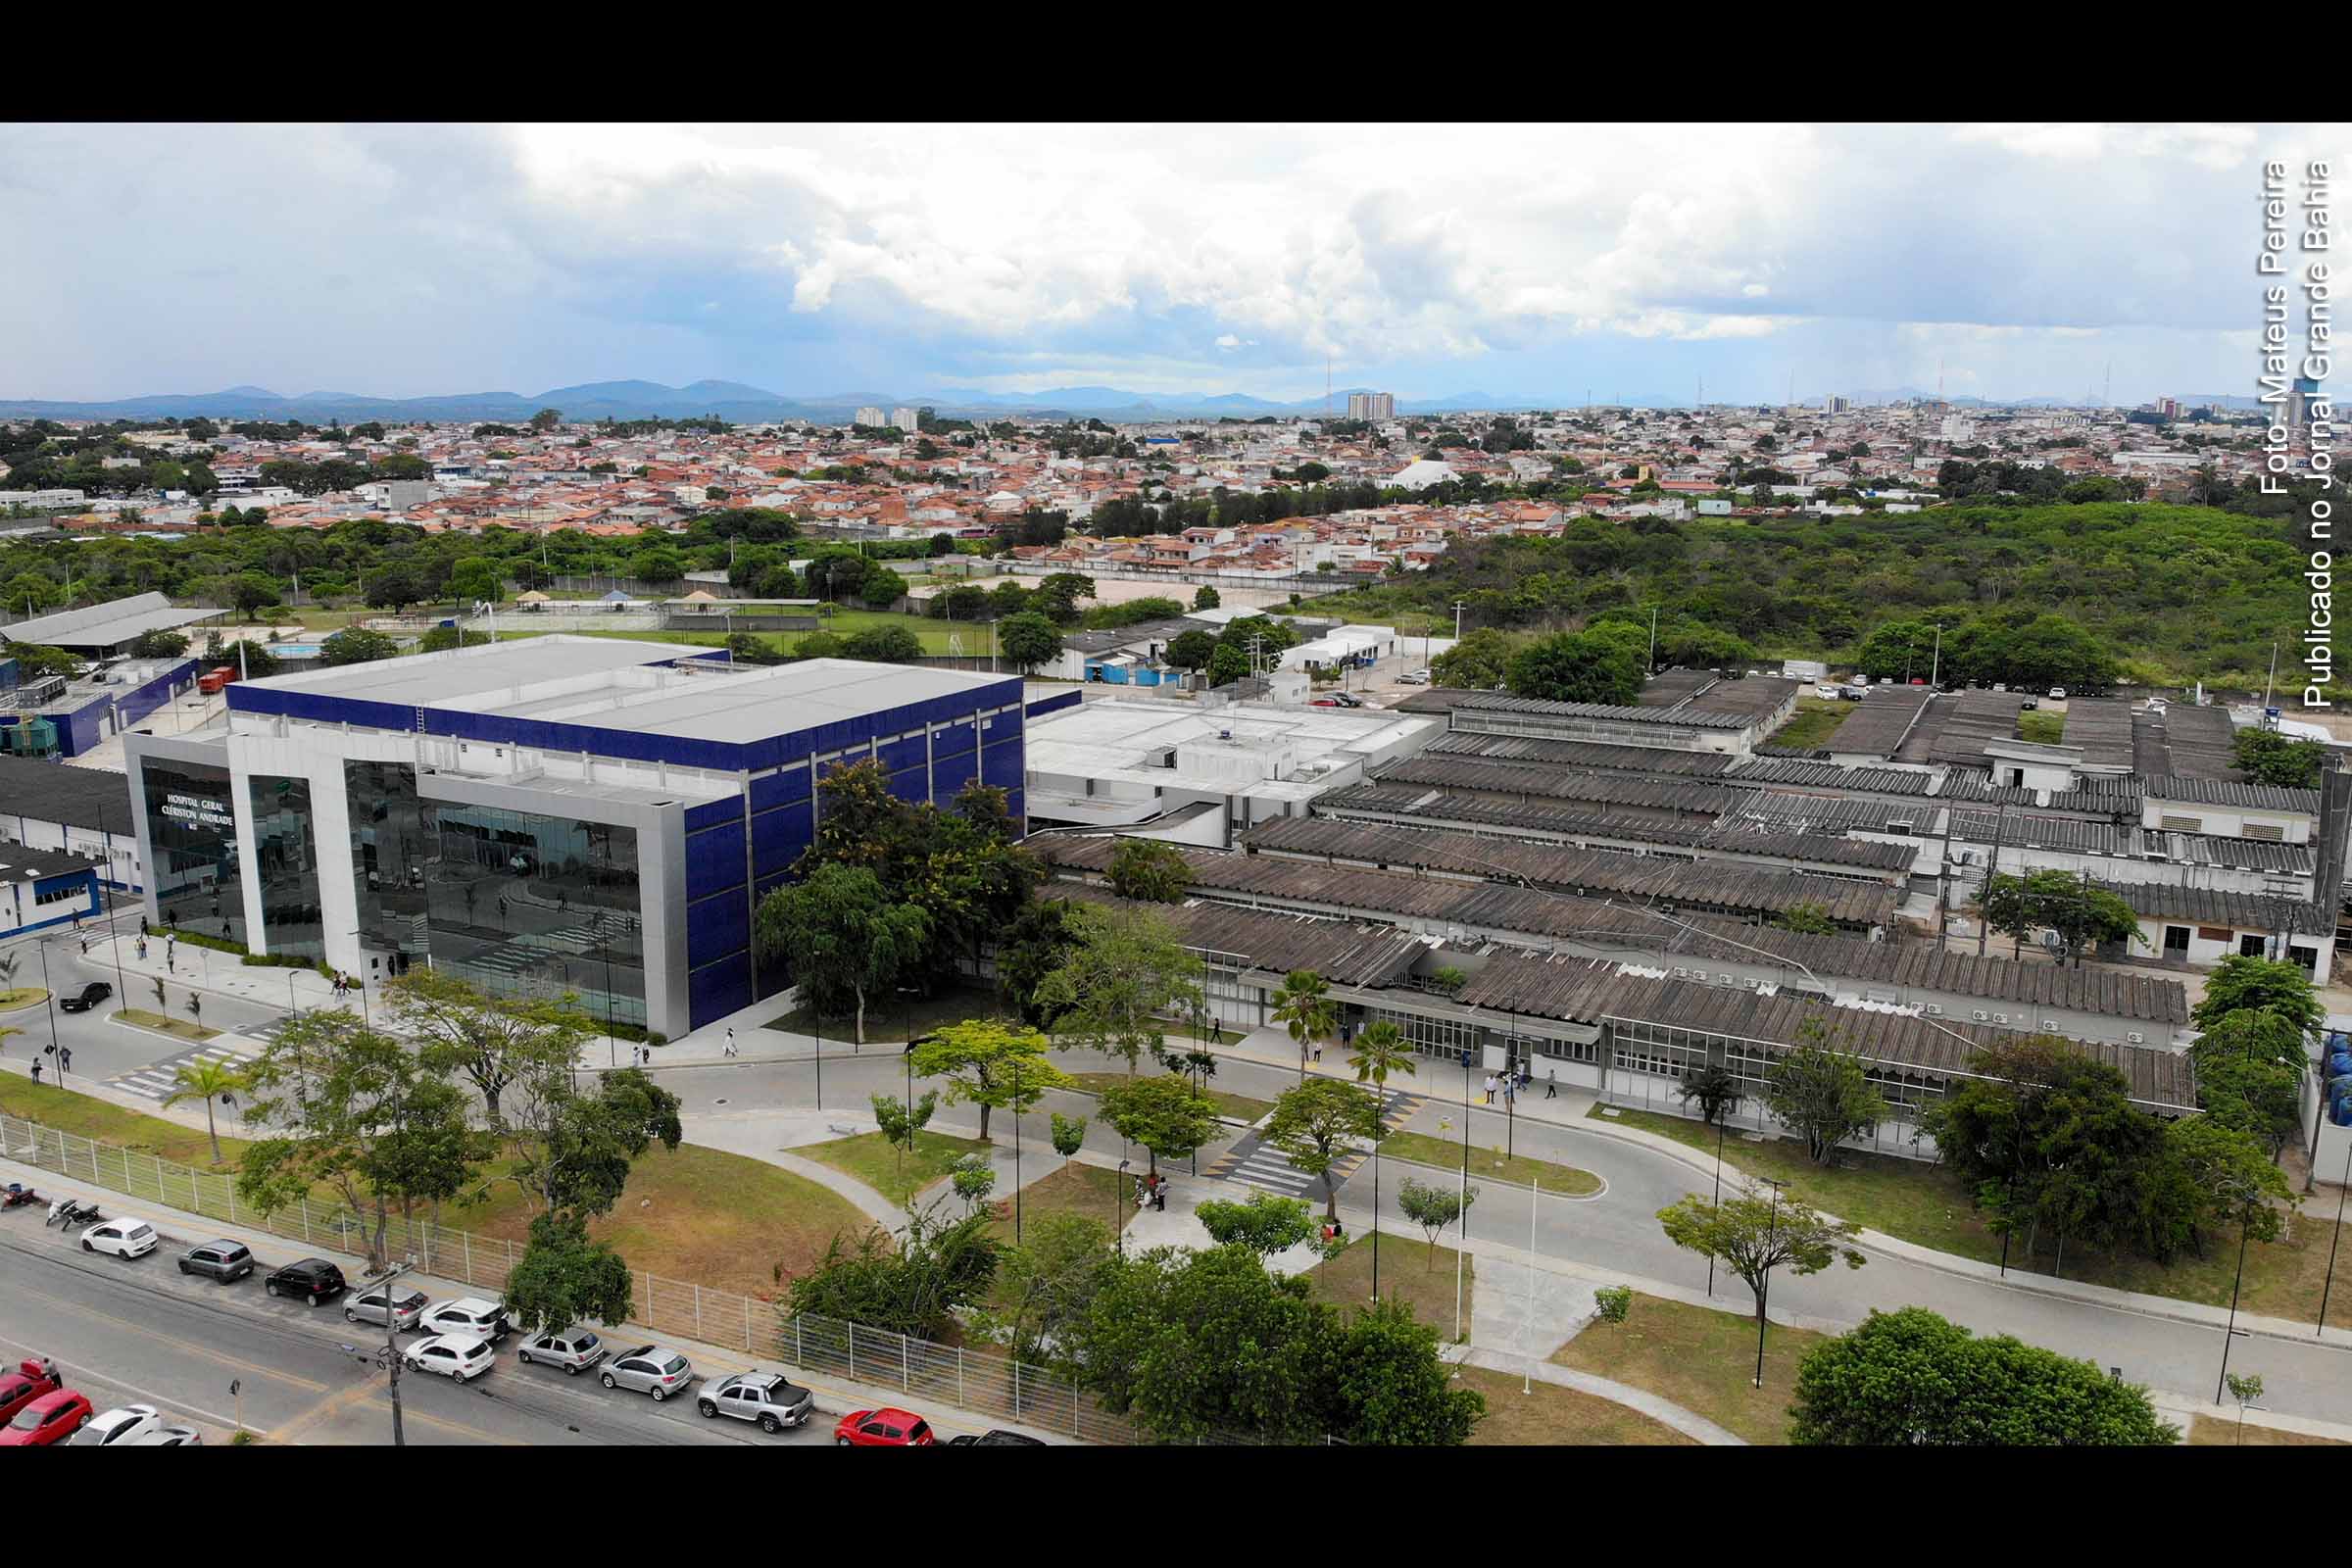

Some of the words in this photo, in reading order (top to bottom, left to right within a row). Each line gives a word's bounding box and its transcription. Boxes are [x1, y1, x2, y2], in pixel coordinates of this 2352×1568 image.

[167, 794, 198, 808] HOSPITAL
[201, 800, 224, 812] GERAL
[161, 805, 197, 819] CLÉRISTON
[199, 812, 233, 826] ANDRADE
